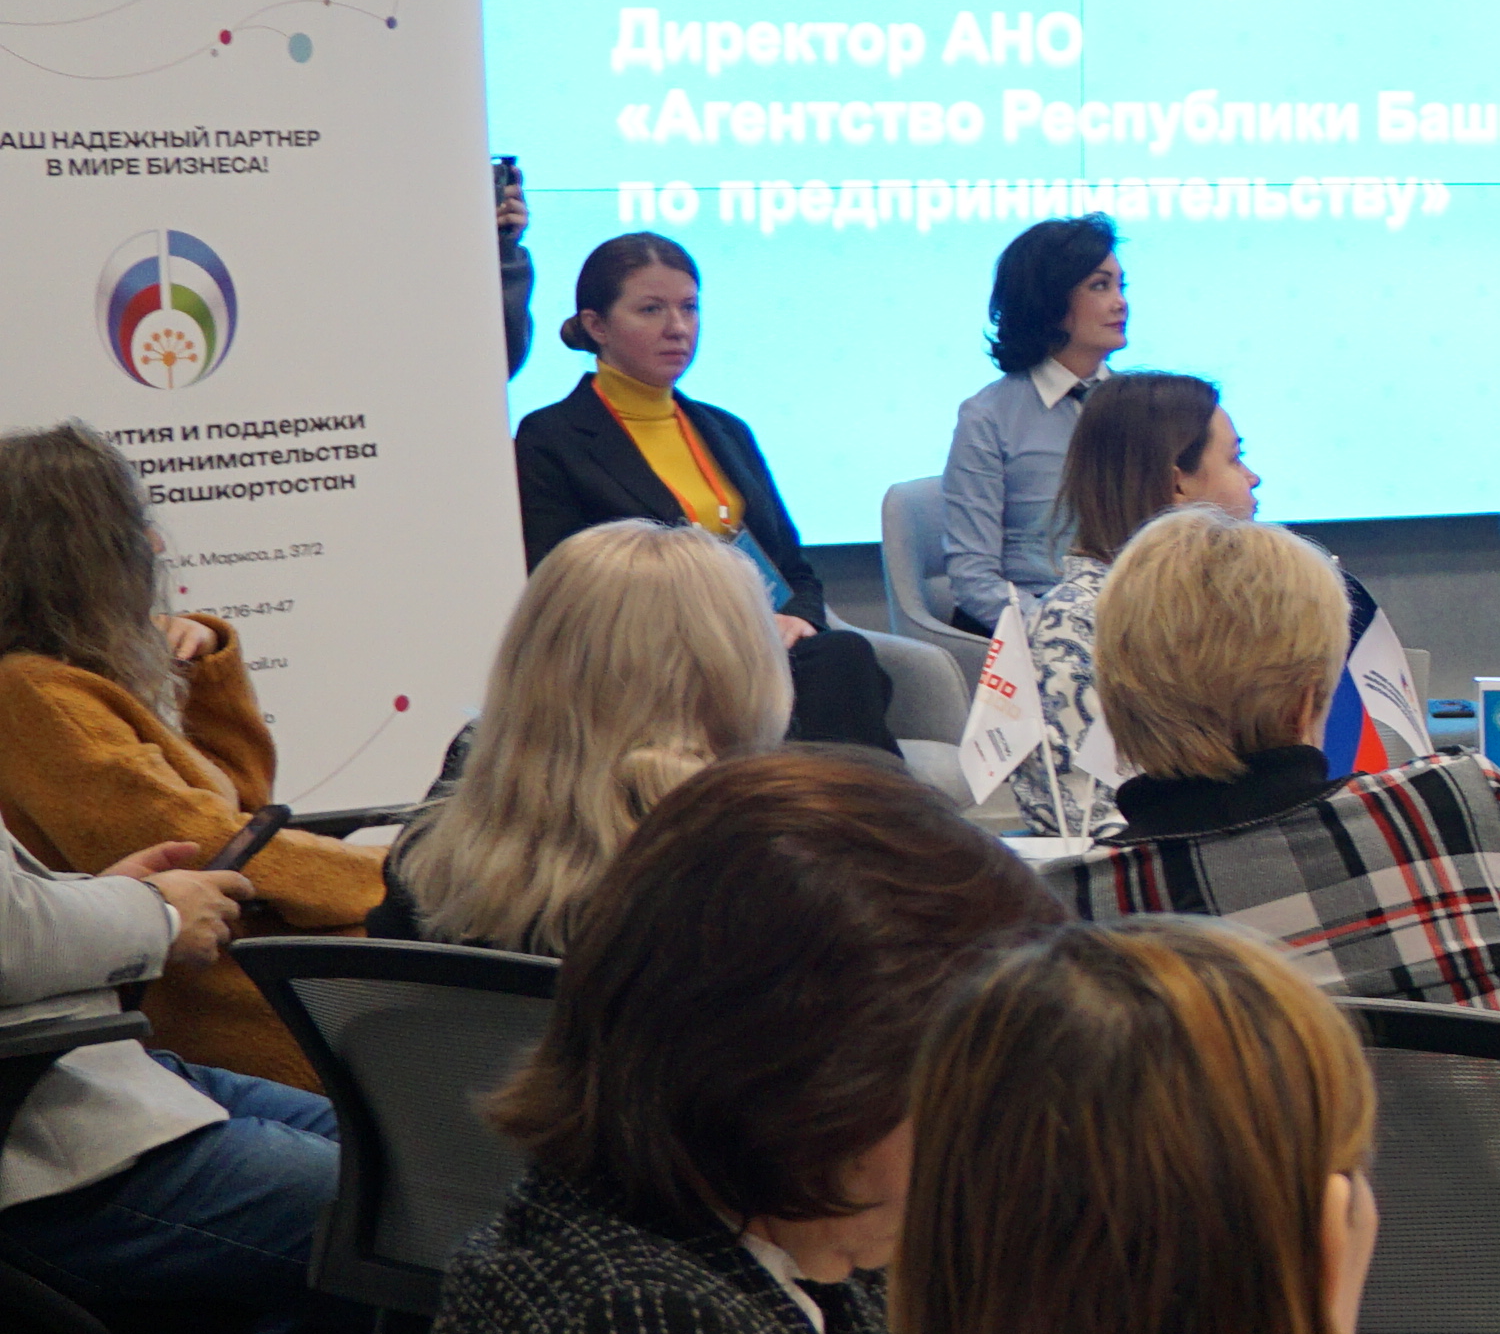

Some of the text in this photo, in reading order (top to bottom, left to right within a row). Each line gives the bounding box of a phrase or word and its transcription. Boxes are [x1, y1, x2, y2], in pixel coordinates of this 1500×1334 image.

[611, 7, 1084, 77] Директор АНО
[52, 125, 210, 152] НАДЕЖНЫЙ
[215, 129, 321, 149] ПАРТНЕР
[616, 88, 986, 144] «Агентство
[1002, 90, 1361, 158] Республики
[46, 155, 270, 176] В МИРЕ БИЗНЕСА!
[617, 176, 1453, 236] по предпринимательству»
[181, 412, 366, 441] и поддержки
[148, 473, 356, 505] Башкортостан
